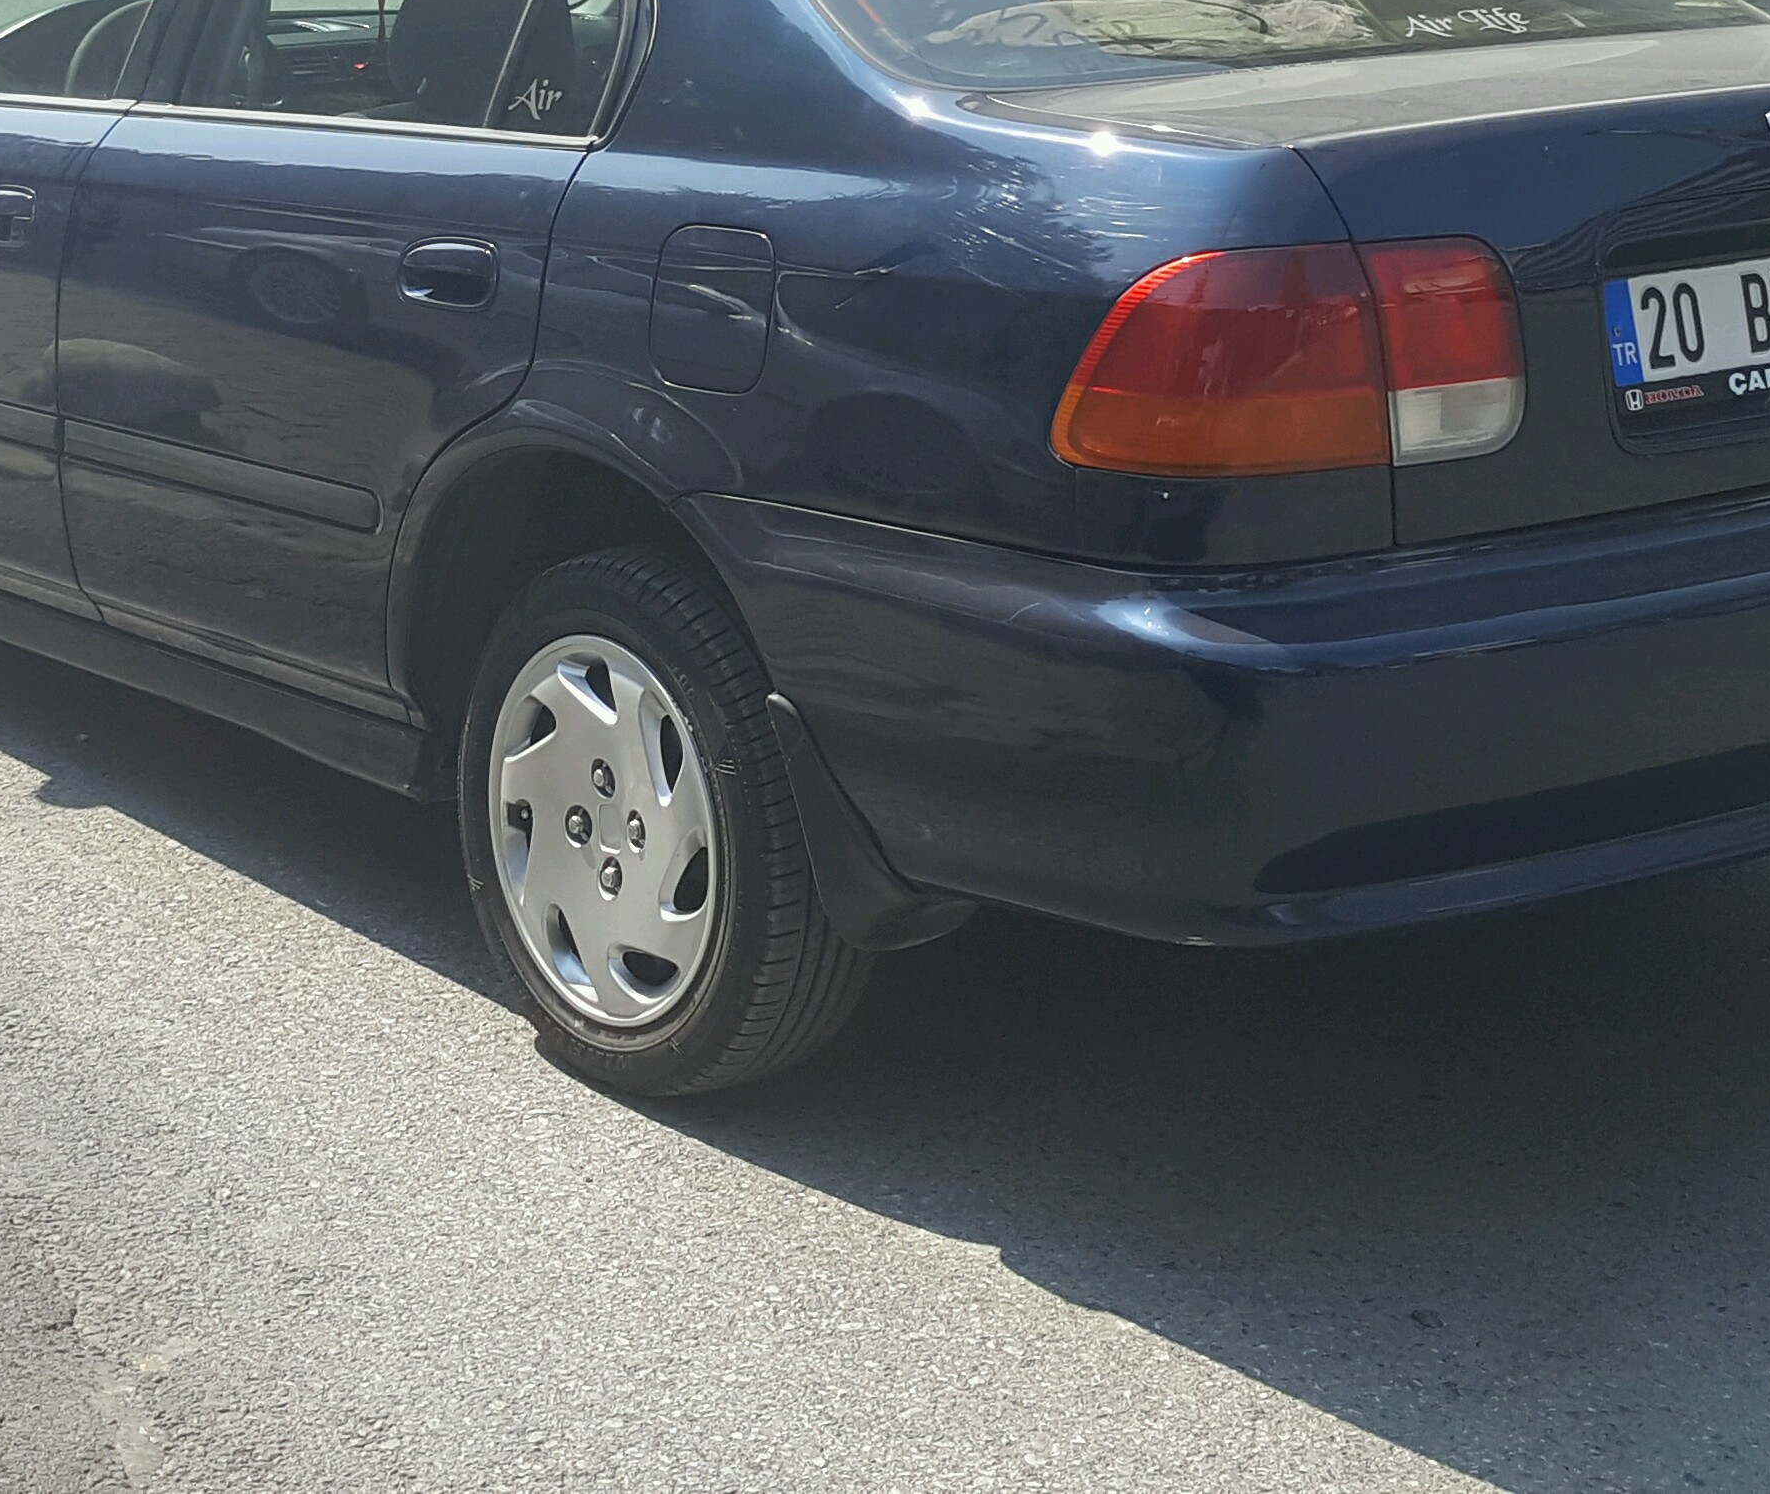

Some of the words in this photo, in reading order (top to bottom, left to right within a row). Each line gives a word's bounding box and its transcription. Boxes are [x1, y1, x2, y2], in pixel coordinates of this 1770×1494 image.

[1405, 15, 1456, 39] Air
[507, 77, 563, 121] Air
[1639, 282, 1705, 370] 20
[1611, 342, 1639, 367] TR
